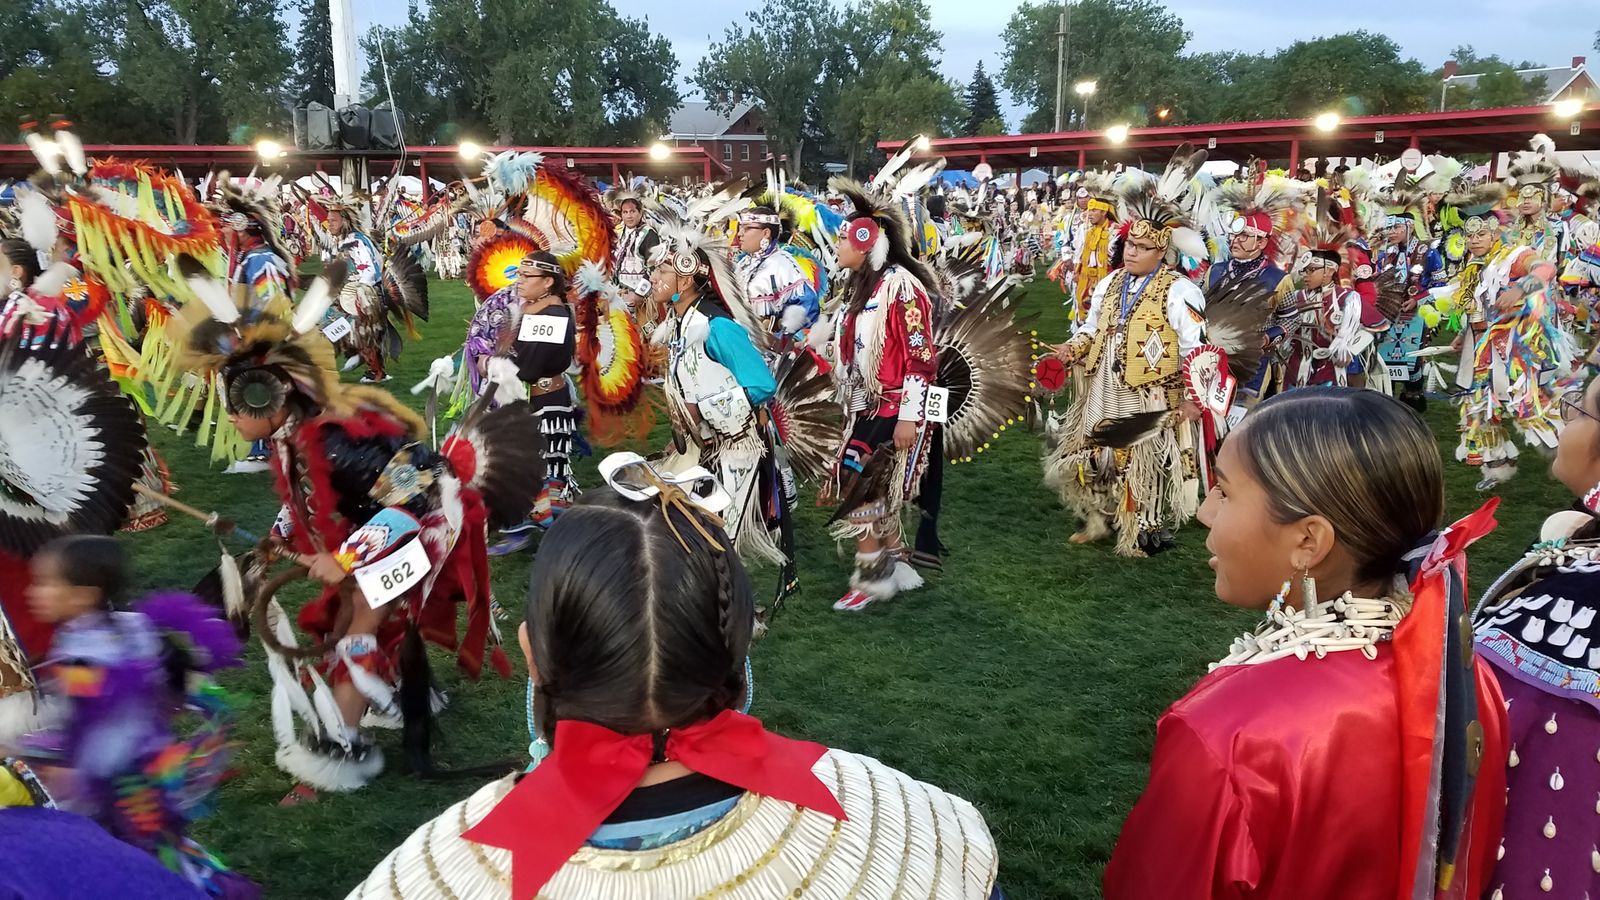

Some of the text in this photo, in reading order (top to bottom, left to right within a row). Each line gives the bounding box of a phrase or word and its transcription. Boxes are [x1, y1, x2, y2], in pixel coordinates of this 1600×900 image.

[532, 324, 554, 337] 960
[1389, 368, 1403, 377] 810
[927, 392, 942, 417] 855
[380, 561, 415, 590] 862
